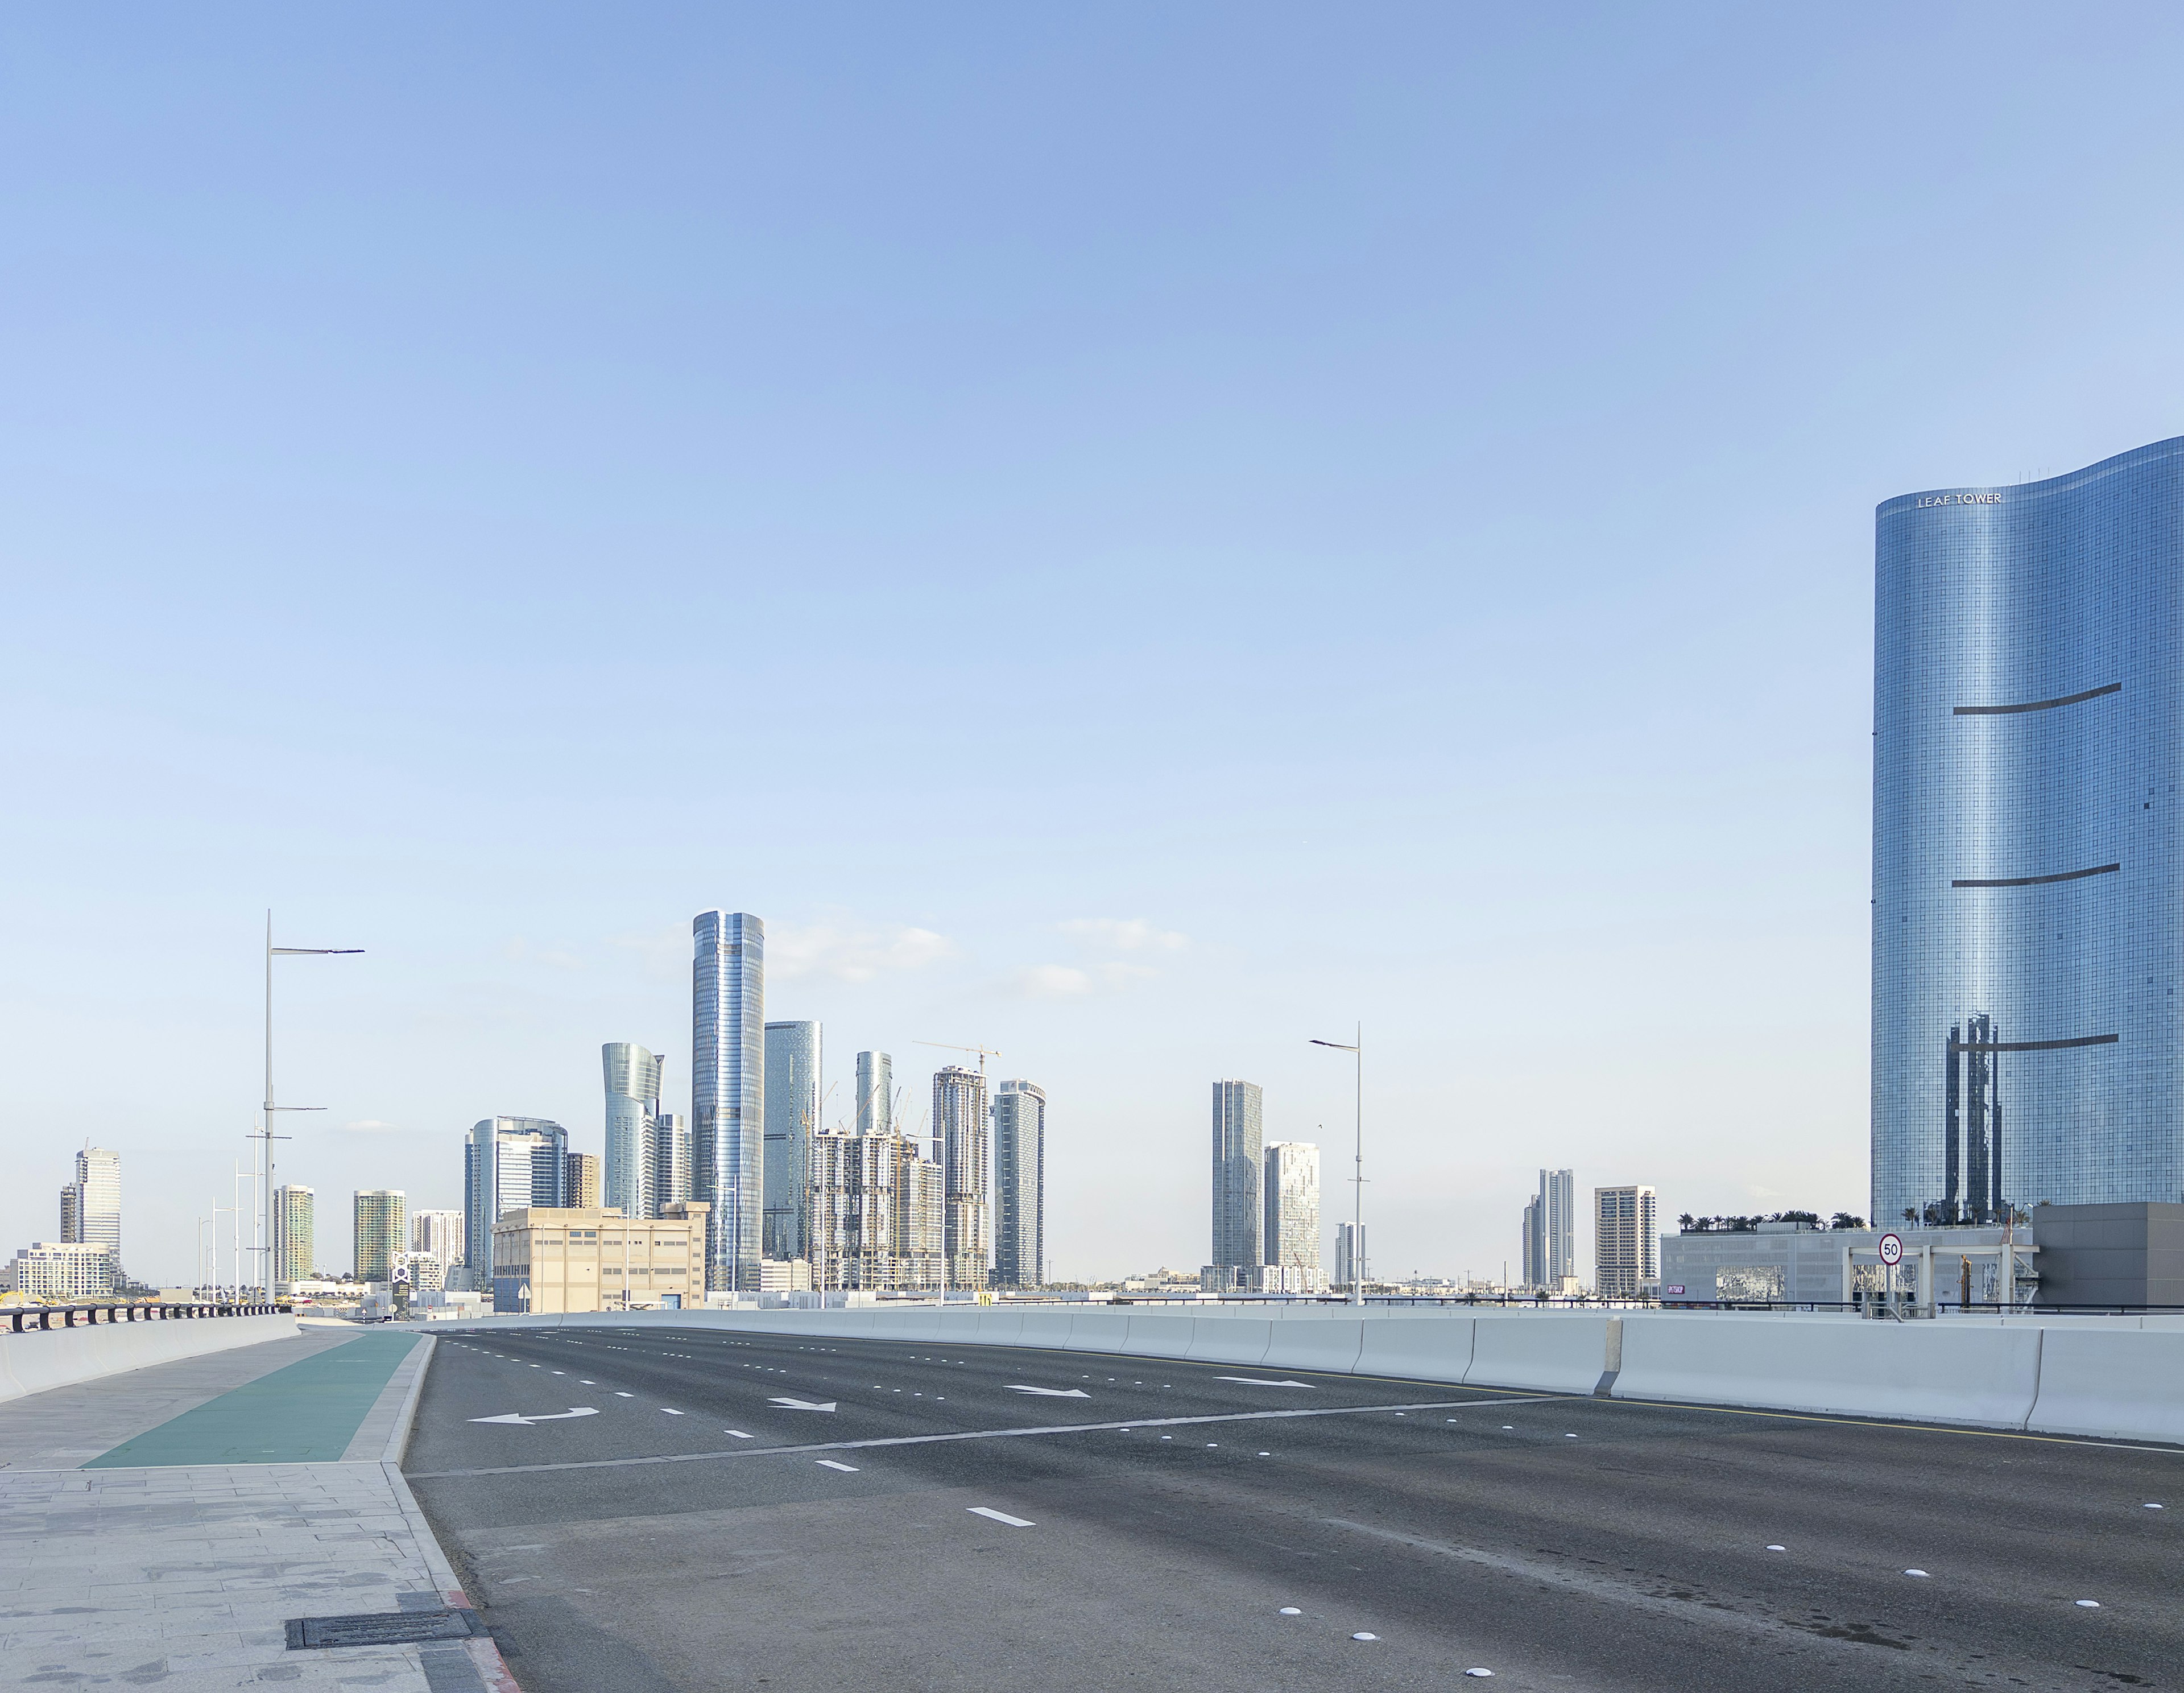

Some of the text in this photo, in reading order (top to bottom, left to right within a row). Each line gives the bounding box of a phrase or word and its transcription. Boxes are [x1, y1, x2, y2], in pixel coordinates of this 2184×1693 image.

[1918, 493, 2002, 508] LEAF TOWER
[1884, 1244, 1898, 1256] 50
